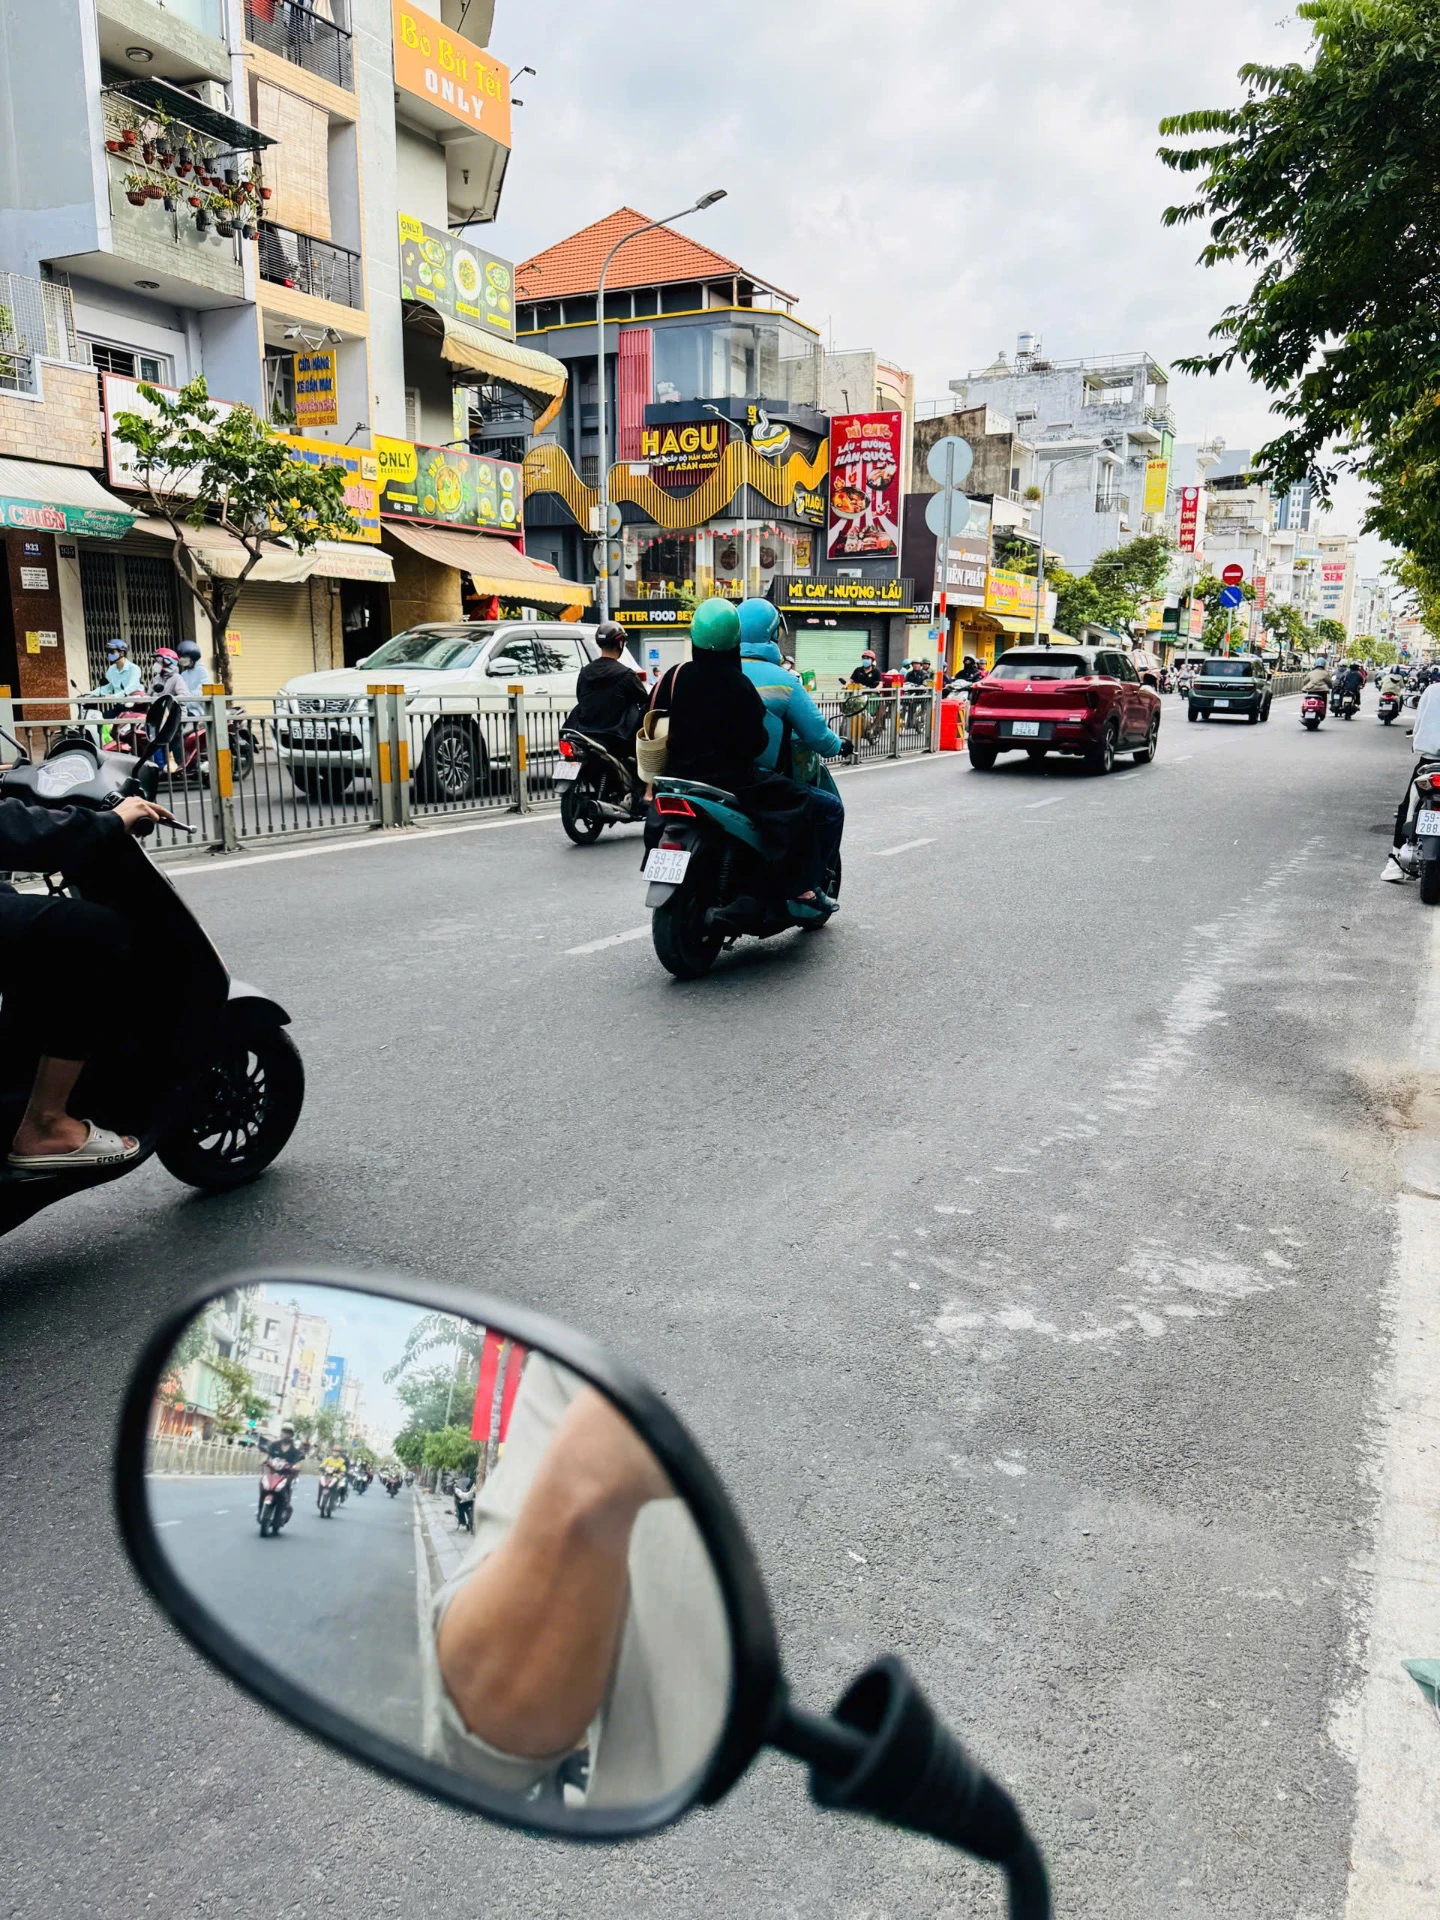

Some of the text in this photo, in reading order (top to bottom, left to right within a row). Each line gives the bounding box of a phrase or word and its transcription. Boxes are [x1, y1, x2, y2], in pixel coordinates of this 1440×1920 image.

[425, 67, 484, 120] ONLY
[401, 220, 420, 234] ONLY
[642, 425, 718, 456] HAGU
[379, 451, 412, 468] ONLY
[834, 449, 896, 467] HÀN QUỐC
[676, 461, 698, 472] ASAN
[699, 462, 718, 470] GROUP
[804, 492, 825, 512] HAGU
[25, 543, 39, 551] 933
[964, 566, 986, 588] PHÁT
[1324, 572, 1343, 581] SEN
[788, 579, 803, 597] MÌ
[805, 584, 828, 597] CAY
[833, 581, 875, 599] NƯỚNG
[881, 579, 903, 599] LẨU
[614, 611, 648, 621] BETTER
[649, 610, 676, 621] FOOD
[653, 851, 683, 867] 59-T2
[647, 866, 683, 881] 687.08
[96, 1153, 125, 1164] crocs
